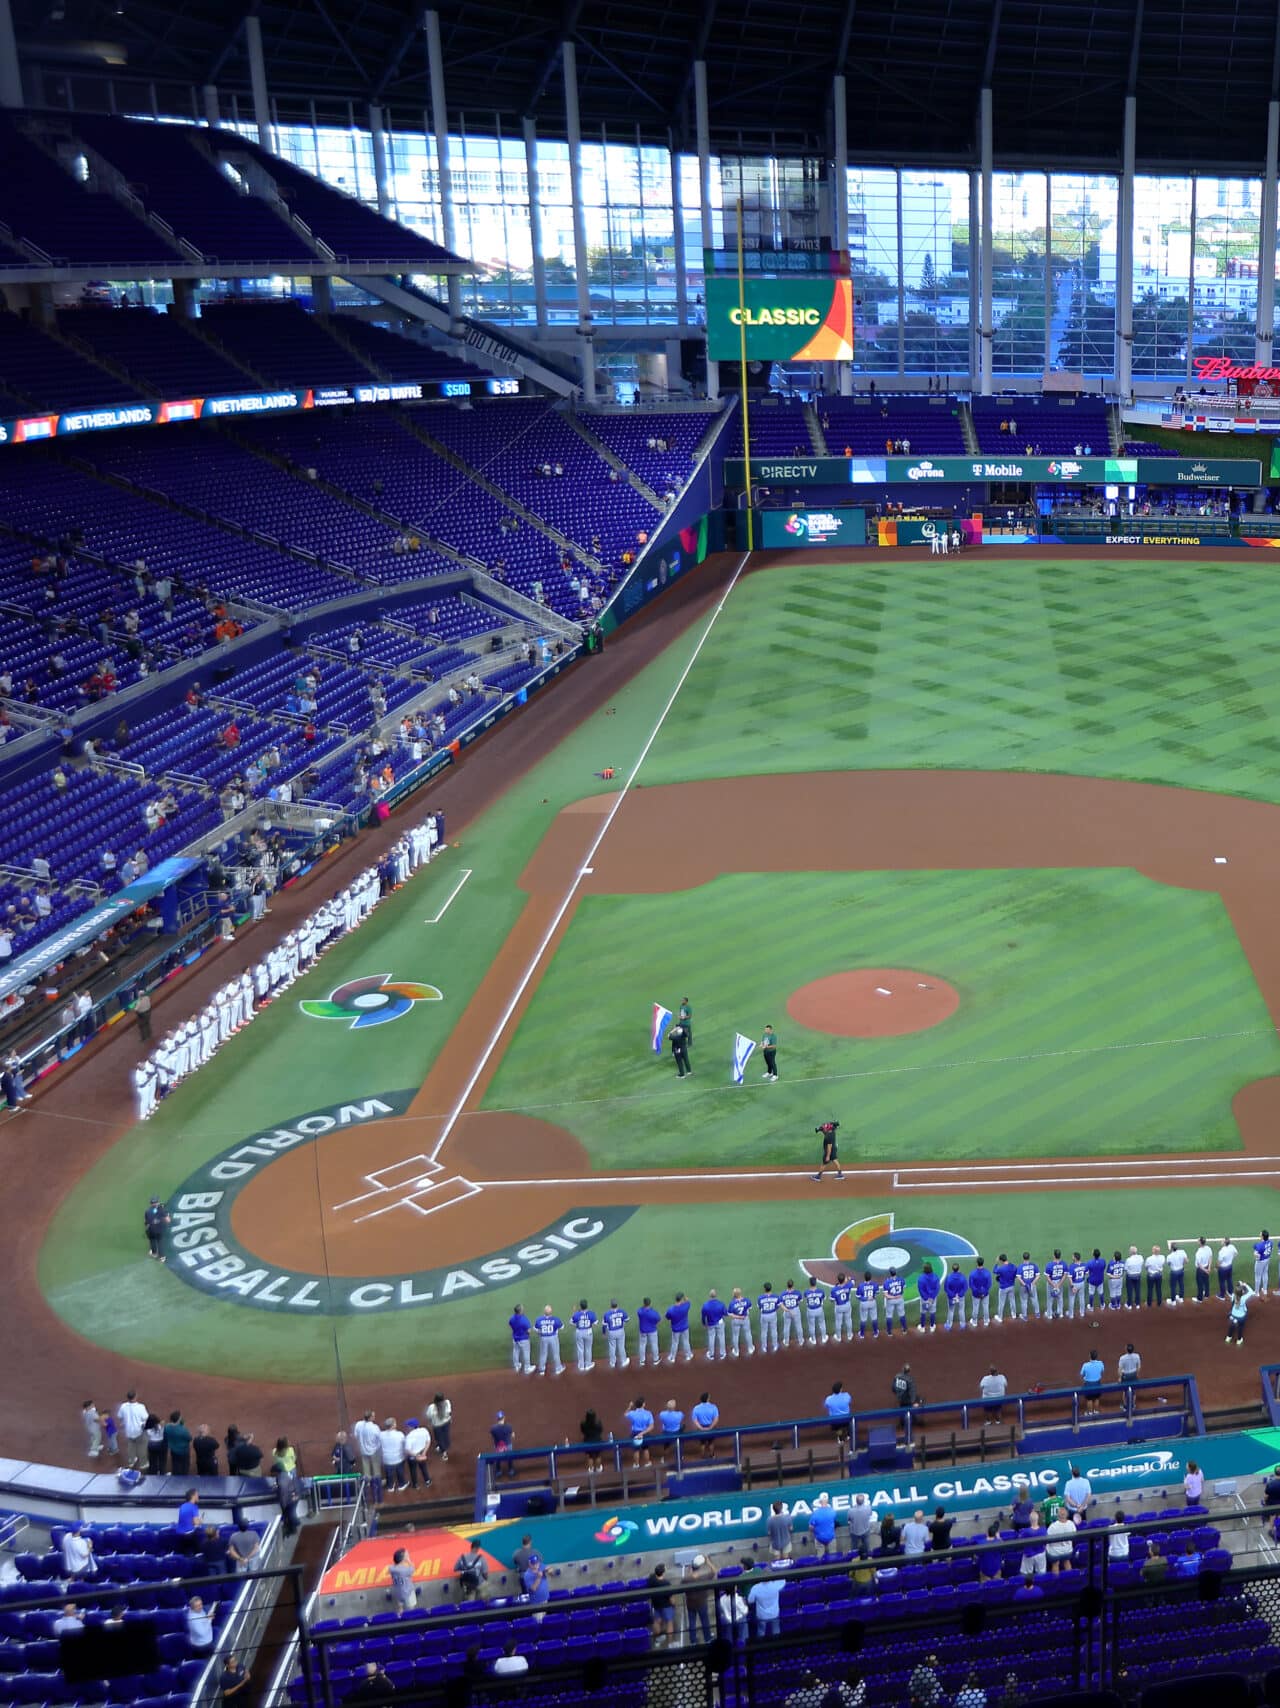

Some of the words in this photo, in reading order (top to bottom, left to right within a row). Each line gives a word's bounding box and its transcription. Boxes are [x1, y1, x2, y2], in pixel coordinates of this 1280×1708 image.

[729, 308, 820, 325] CLASSIC
[211, 394, 297, 413] NETHERLANDS
[66, 408, 152, 431] NETHERLANDS
[761, 465, 818, 478] DIRECTV
[907, 466, 945, 480] Corona
[984, 463, 1023, 477] Mobile
[1177, 472, 1220, 481] Budweiser
[1105, 536, 1141, 544] EXPECT
[1143, 536, 1200, 545] EVERYTHING
[75, 908, 119, 932] WORLD
[209, 1098, 395, 1180] WORLD
[170, 1190, 321, 1308] BASEBALL
[349, 1217, 605, 1308] CLASSIC
[646, 1506, 762, 1536] WORLD
[933, 1469, 1060, 1498] CLASSIC
